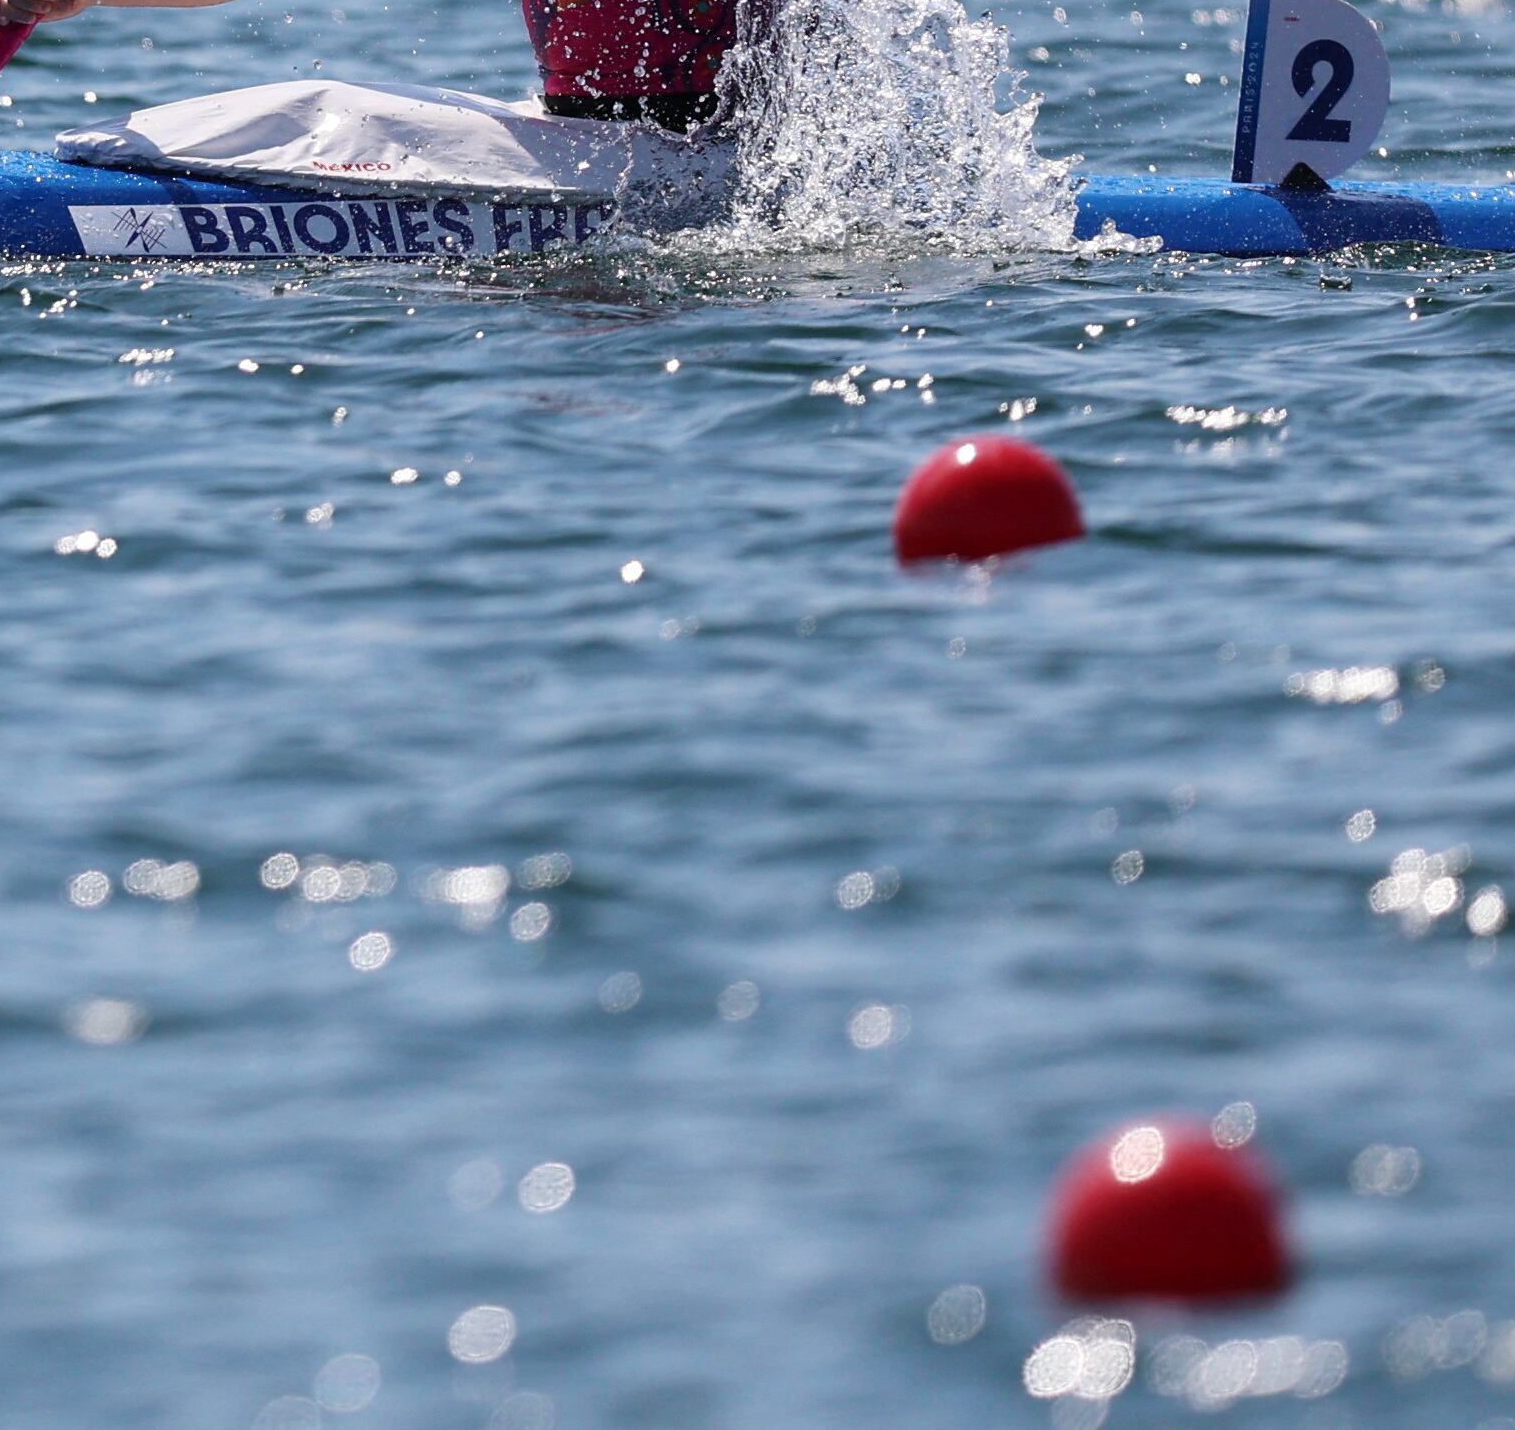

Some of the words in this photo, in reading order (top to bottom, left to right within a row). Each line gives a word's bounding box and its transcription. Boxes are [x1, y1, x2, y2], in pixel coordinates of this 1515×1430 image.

[1247, 41, 1260, 83] 2024
[1285, 39, 1355, 143] 2
[312, 161, 392, 172] MEXICO
[179, 199, 475, 254] BRIONES
